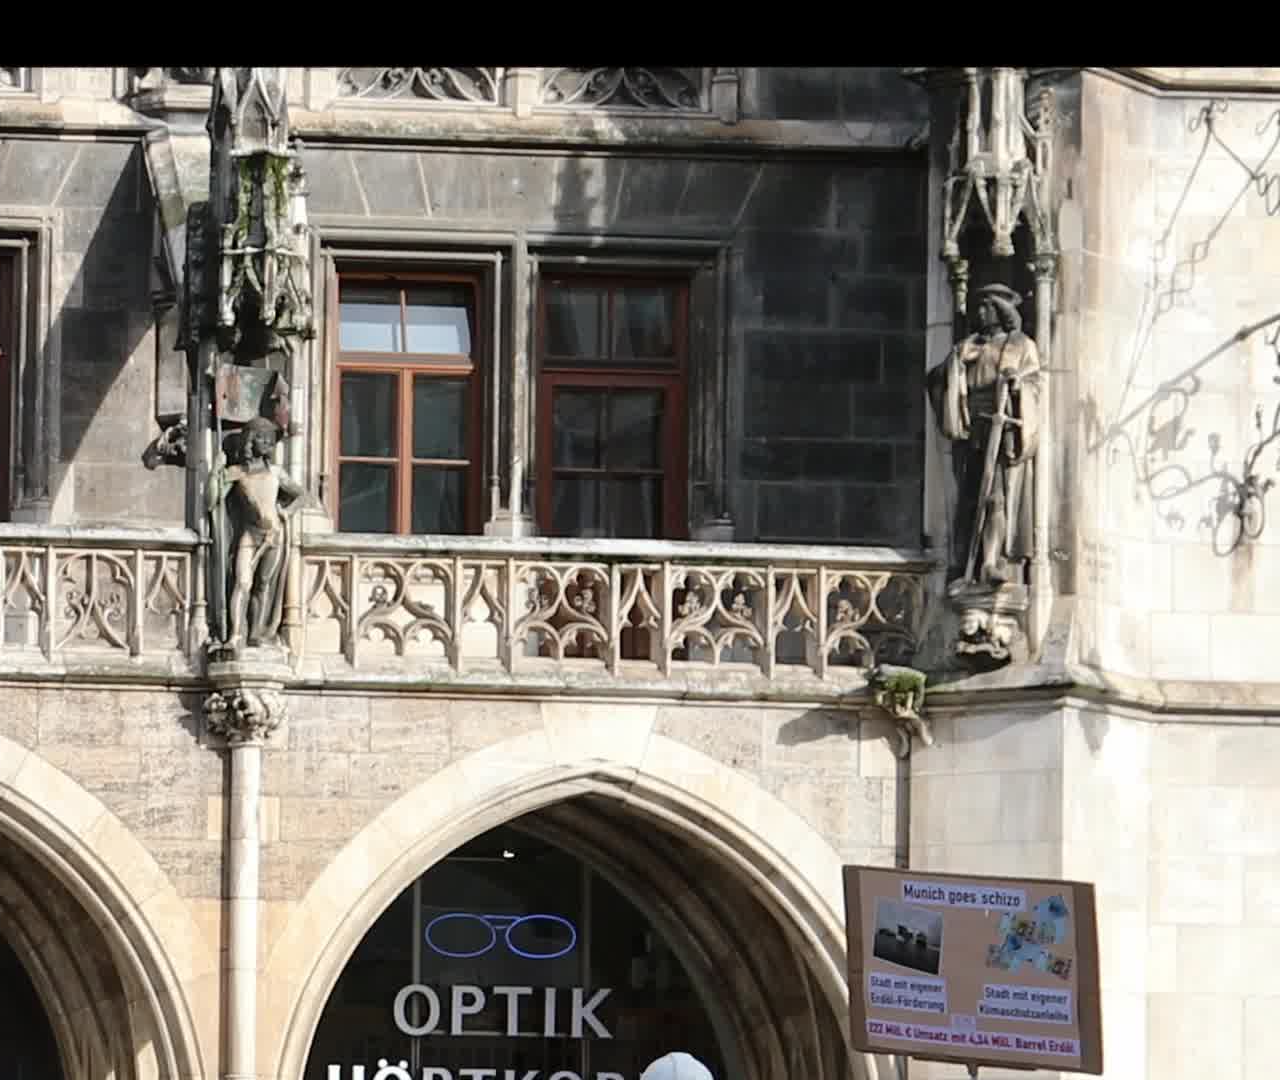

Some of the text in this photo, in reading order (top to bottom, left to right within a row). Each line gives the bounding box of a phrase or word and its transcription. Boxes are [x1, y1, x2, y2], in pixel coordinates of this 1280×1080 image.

[903, 884, 1020, 907] Munich goes schizo
[985, 986, 1010, 1001] Stadt
[393, 983, 613, 1039] OPTIK
